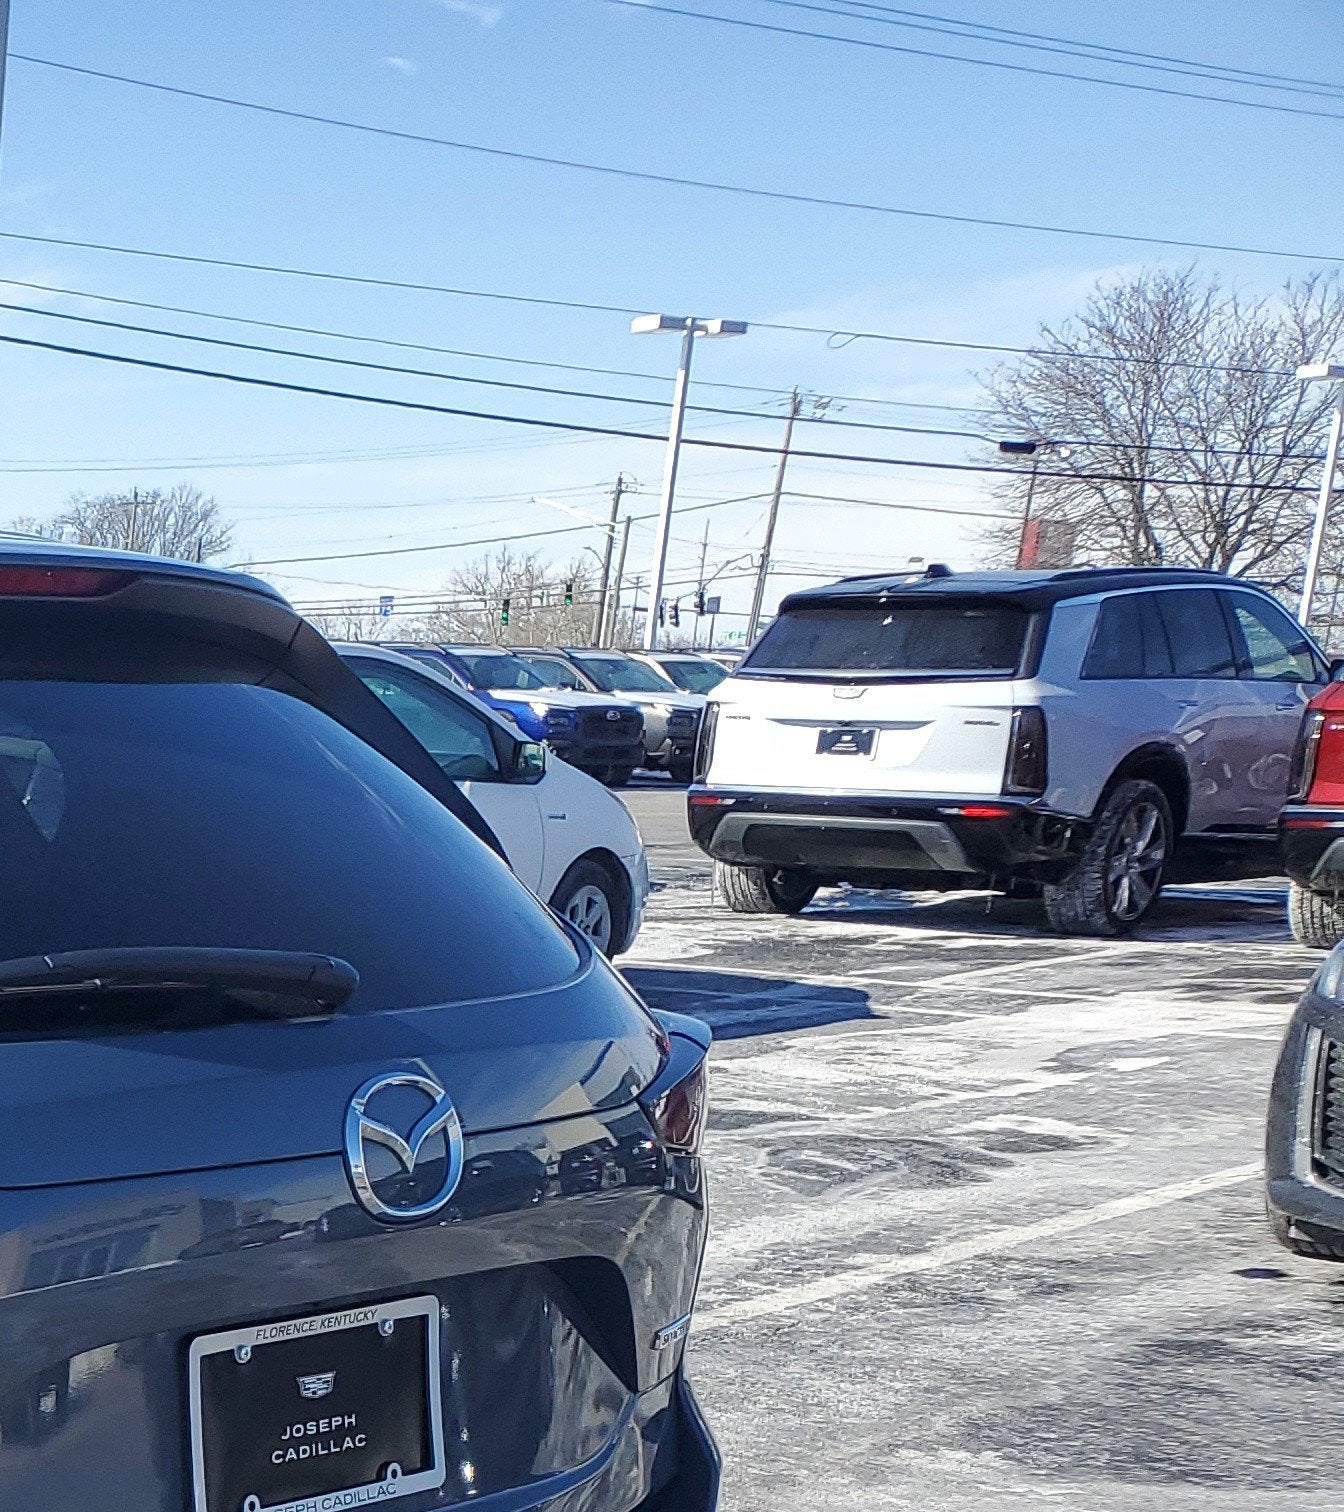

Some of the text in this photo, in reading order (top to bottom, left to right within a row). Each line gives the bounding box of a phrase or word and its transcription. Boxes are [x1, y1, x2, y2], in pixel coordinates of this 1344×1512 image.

[255, 1308, 379, 1341] FLORENCE KENTUCKY
[281, 1413, 357, 1440] JOSEPH
[271, 1433, 368, 1464] CADILLAC
[320, 1482, 398, 1509] CADILLAC
